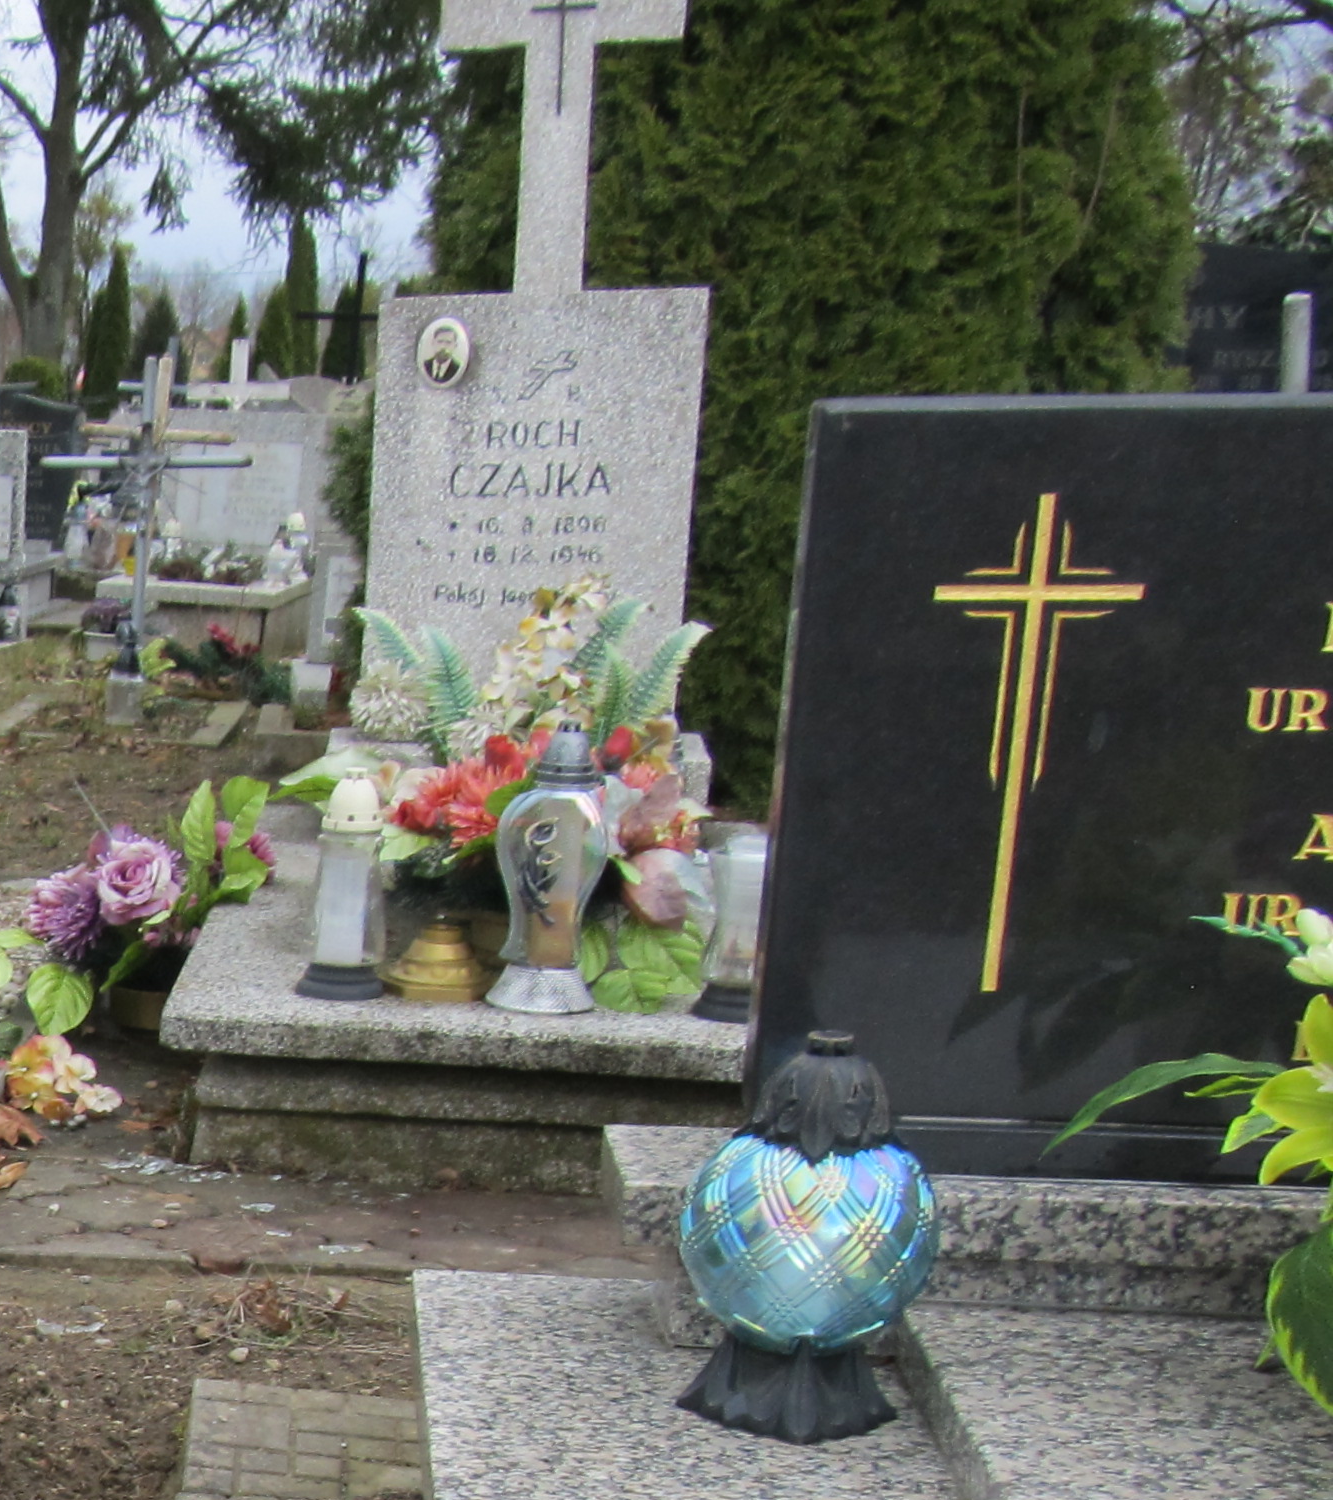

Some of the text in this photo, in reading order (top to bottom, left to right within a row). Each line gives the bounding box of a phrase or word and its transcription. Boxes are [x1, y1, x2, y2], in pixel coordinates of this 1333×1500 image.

[487, 419, 581, 449] ROCH
[450, 462, 611, 498] CZAJKA
[434, 583, 485, 608] Pokój
